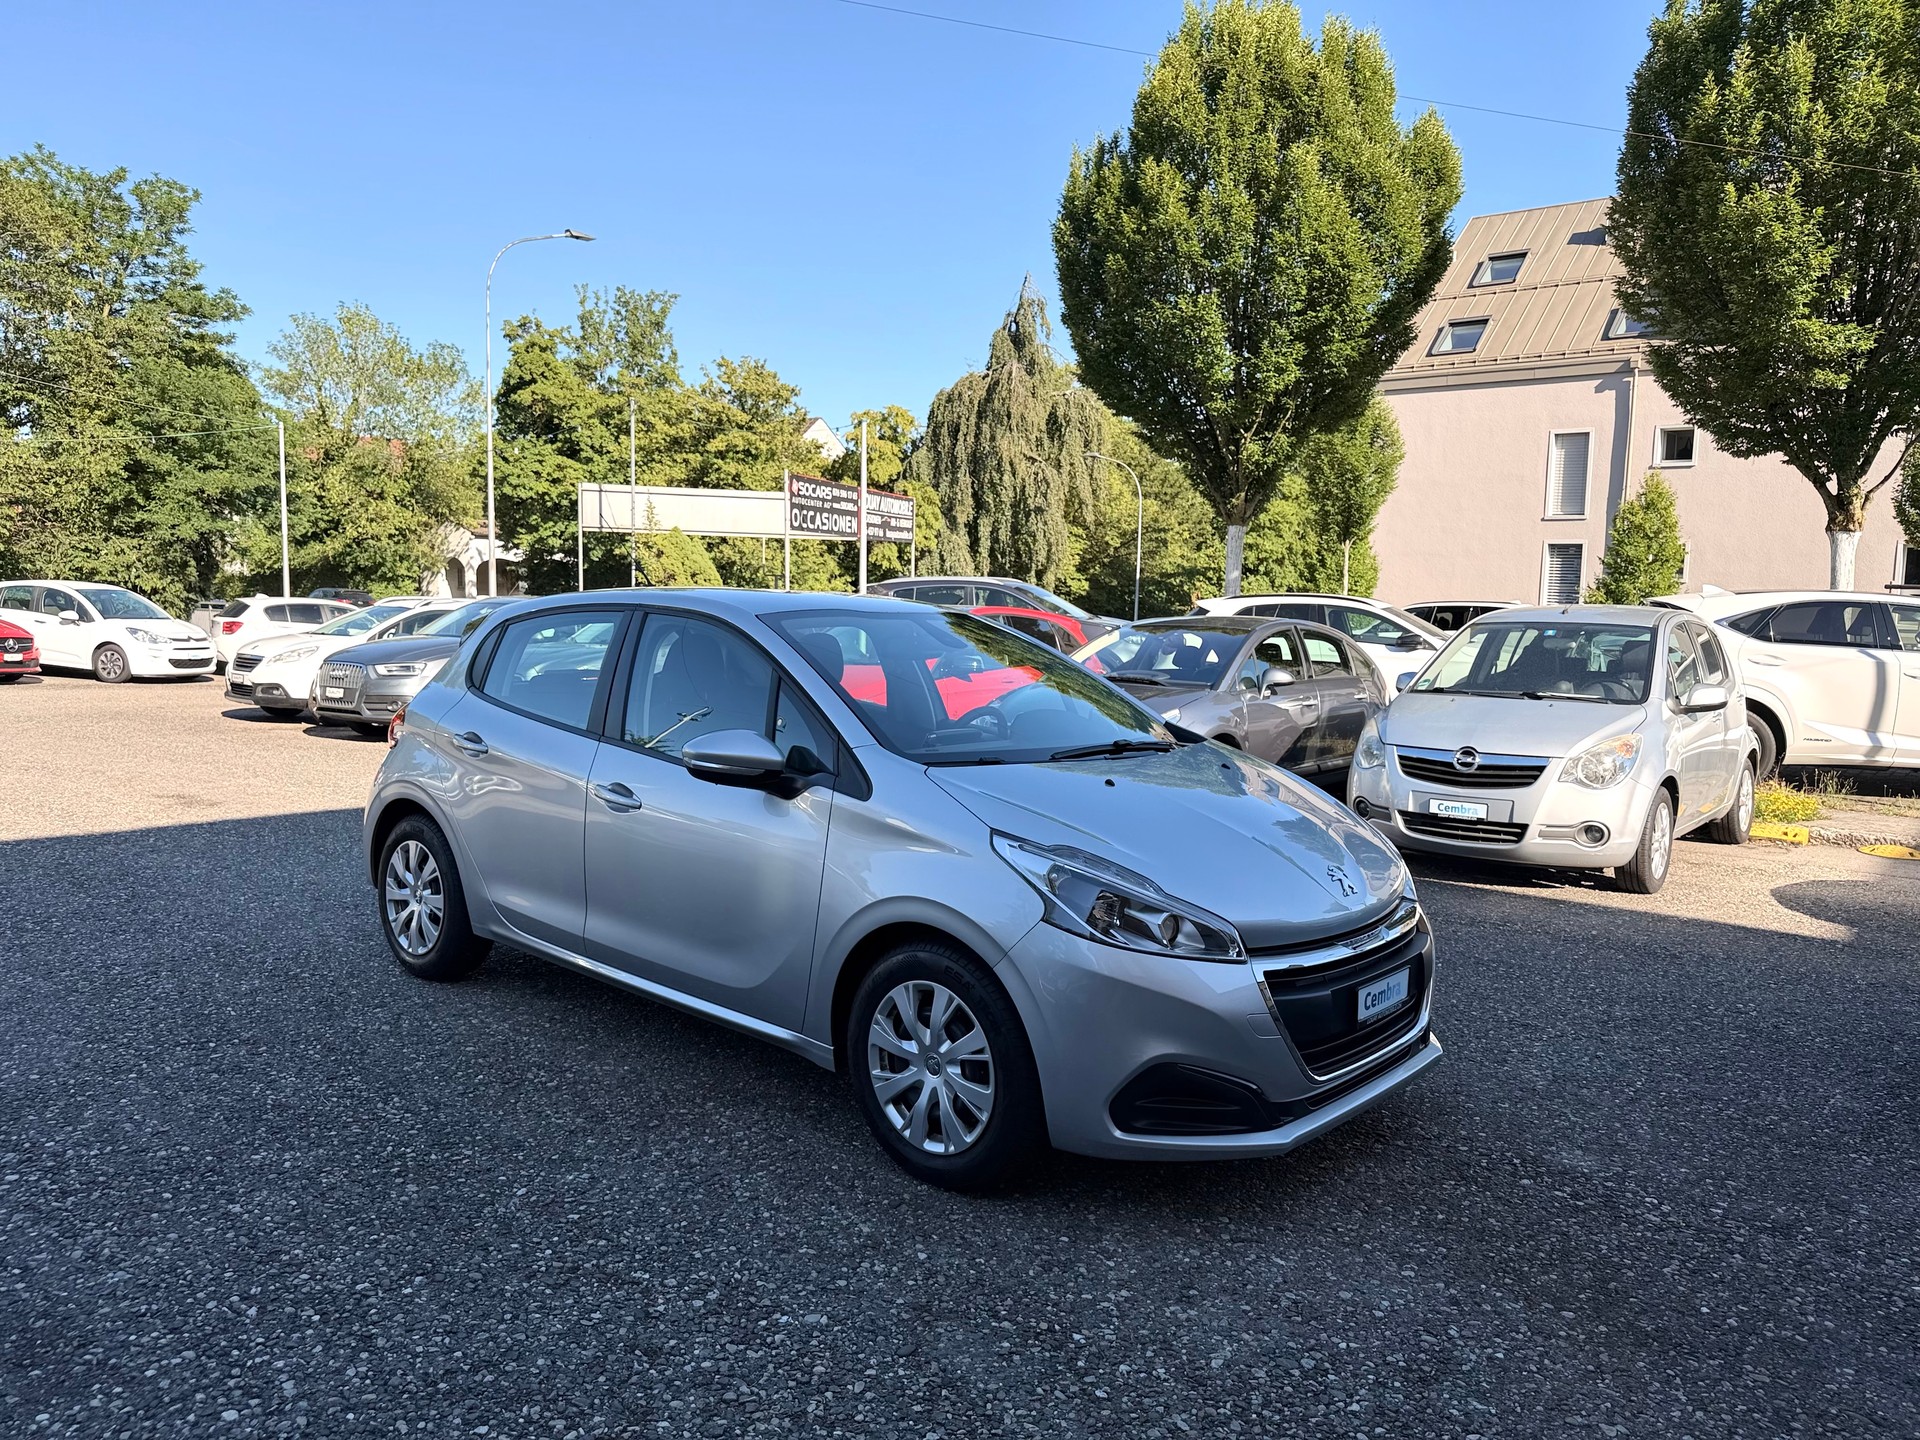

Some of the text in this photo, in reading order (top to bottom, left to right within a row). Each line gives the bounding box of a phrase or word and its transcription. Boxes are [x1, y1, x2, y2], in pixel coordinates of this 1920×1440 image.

[798, 481, 832, 500] SOCARS
[792, 496, 823, 508] AUTOCENTER
[792, 508, 858, 534] OCCASIONEN
[1437, 803, 1479, 816] Cembra
[1364, 981, 1401, 1011] Cembra
